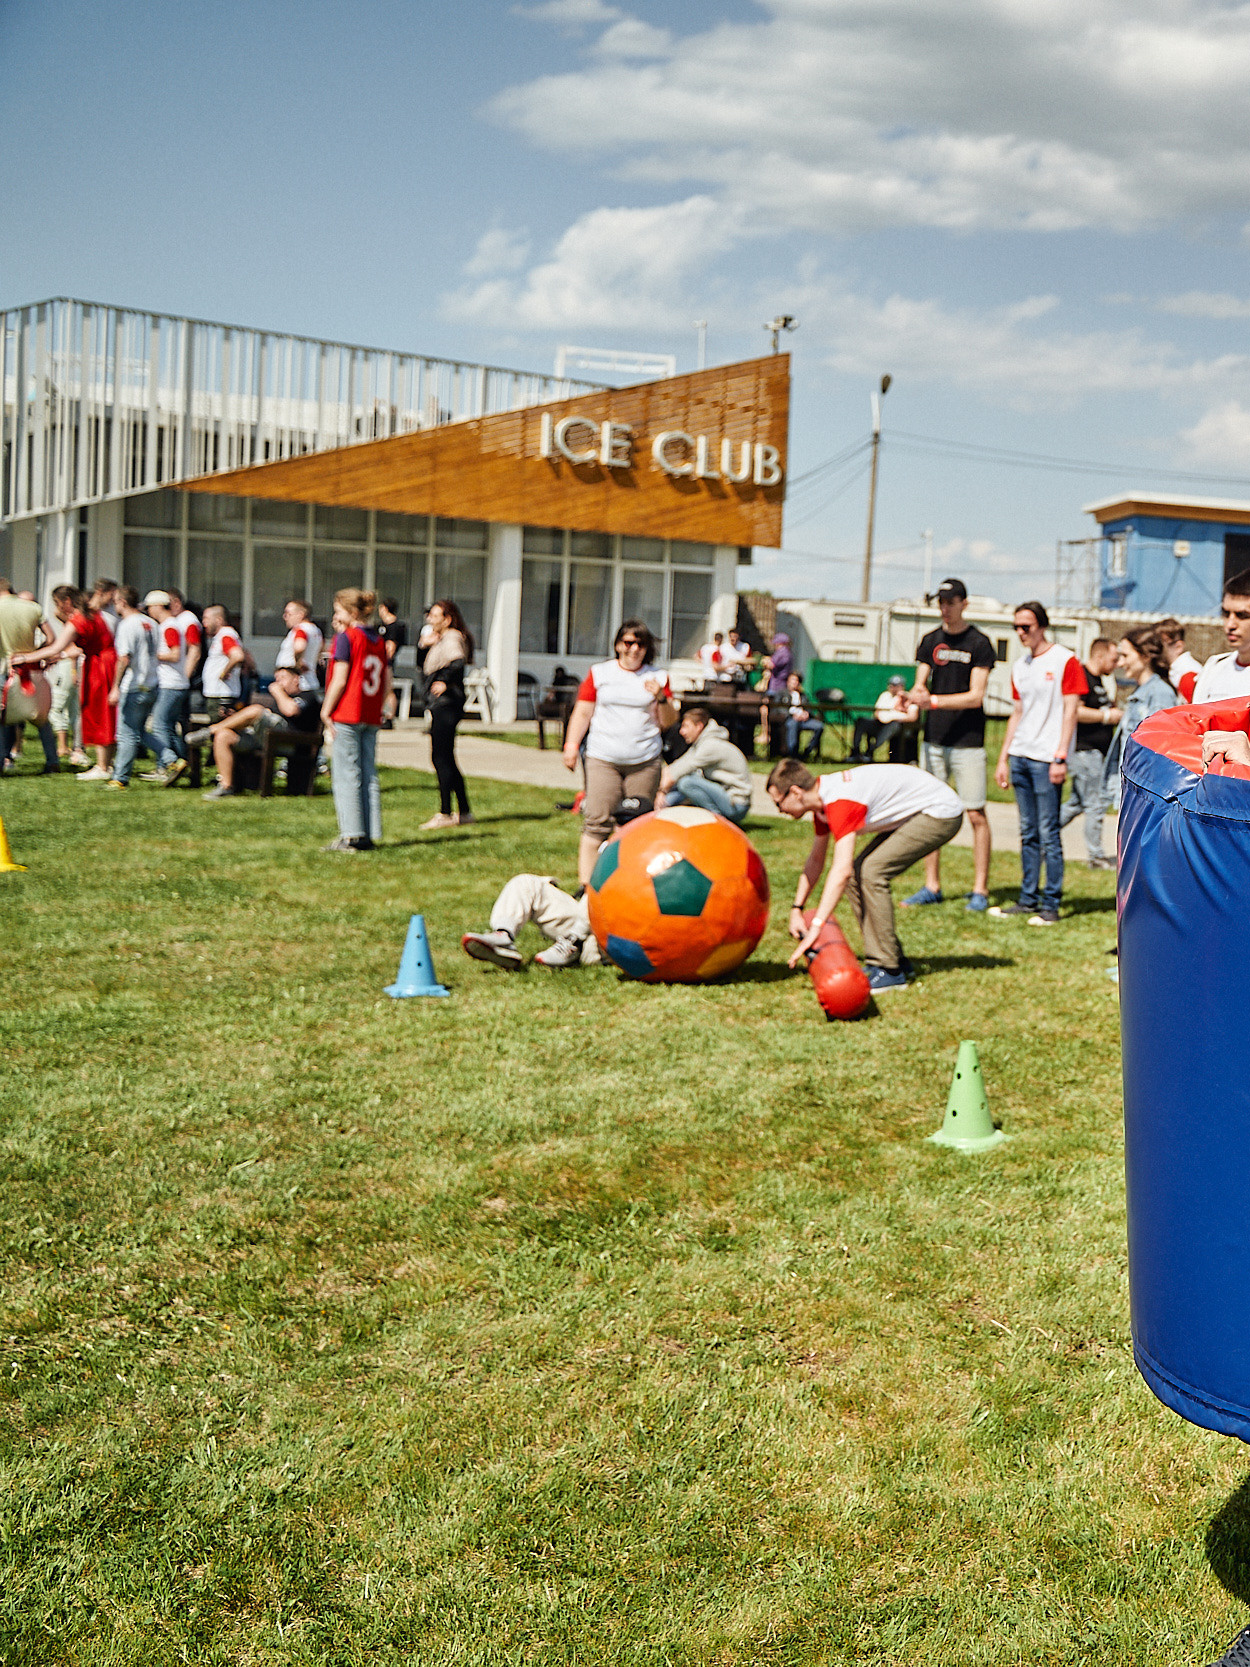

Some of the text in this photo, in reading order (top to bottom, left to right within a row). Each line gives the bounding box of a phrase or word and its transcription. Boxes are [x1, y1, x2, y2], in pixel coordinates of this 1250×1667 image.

[540, 412, 783, 486] ICE CLUB
[362, 654, 383, 696] 3
